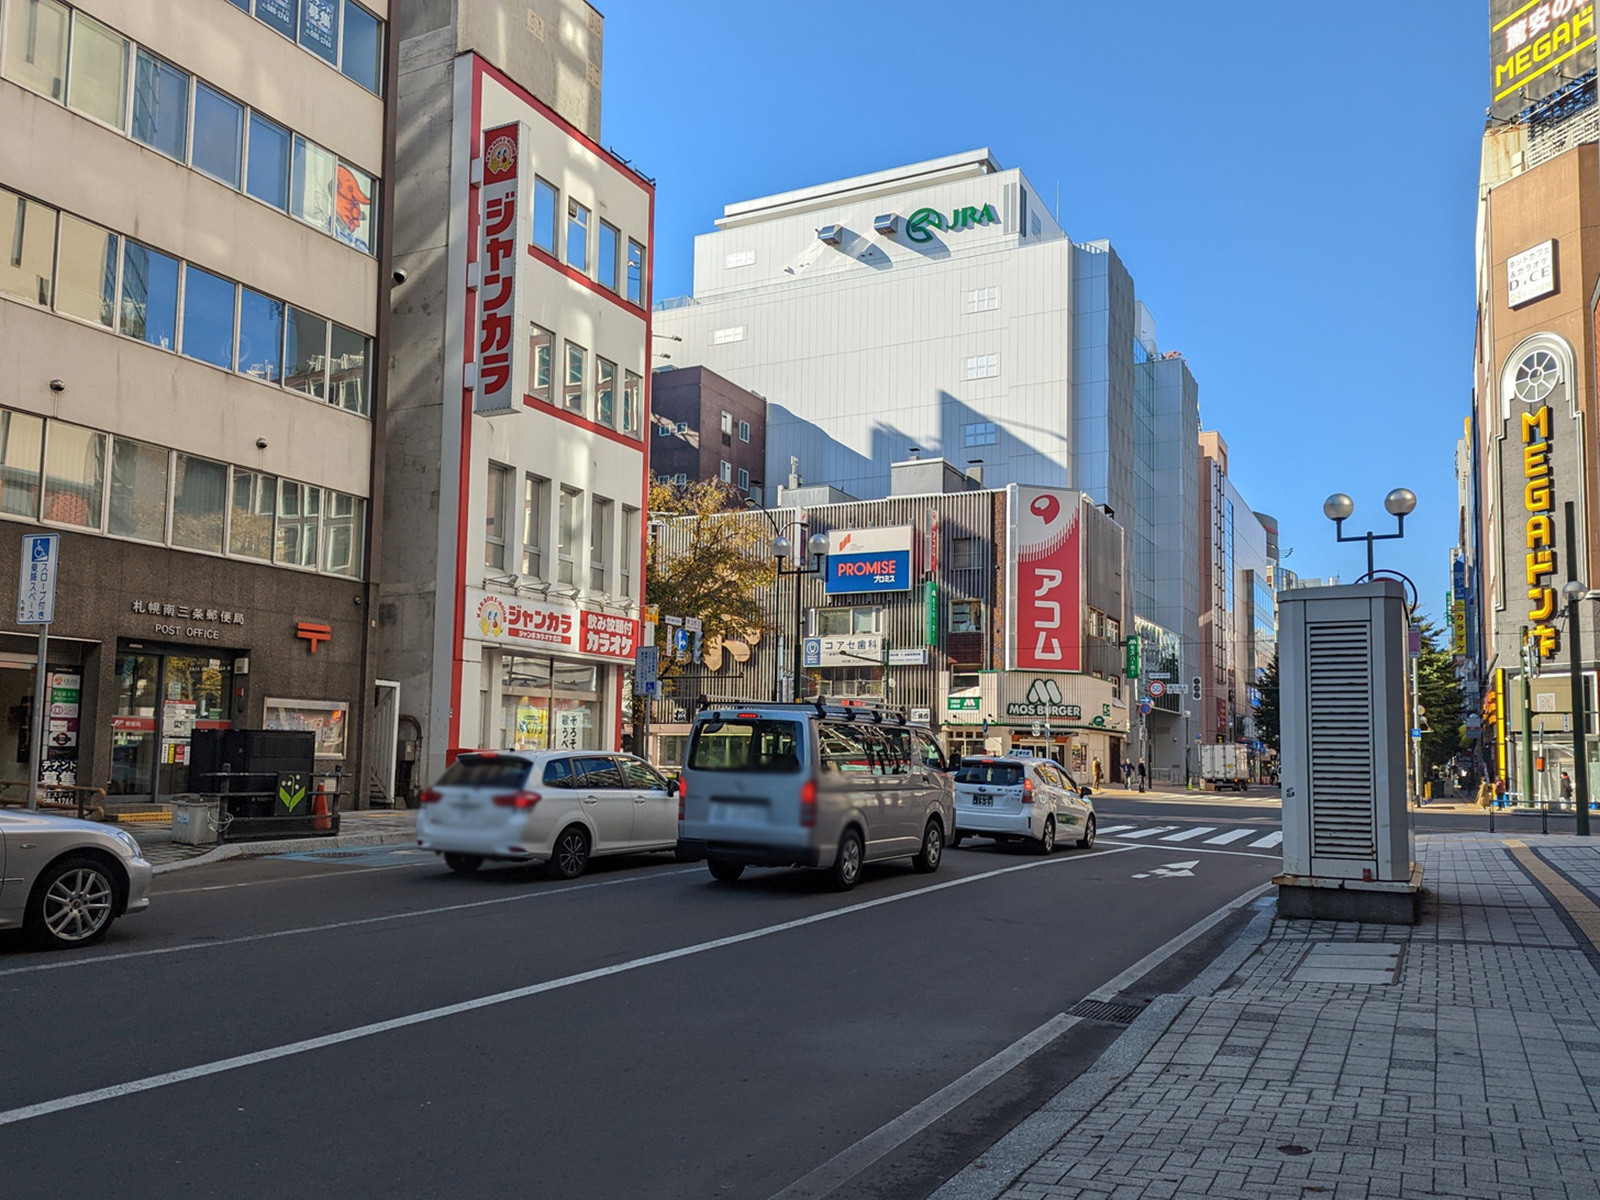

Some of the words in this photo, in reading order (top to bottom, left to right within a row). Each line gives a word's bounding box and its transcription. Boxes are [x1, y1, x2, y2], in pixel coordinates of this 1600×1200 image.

[1505, 0, 1590, 53] 驚安の
[946, 203, 994, 230] JRA
[1509, 247, 1550, 269] ネットカフェ
[481, 191, 515, 395] ジャンカラ
[837, 560, 897, 577] PROMISE
[873, 574, 896, 584] プロミス
[27, 563, 38, 620] 乗降スペース
[38, 563, 48, 620] スロープ付き
[133, 600, 246, 625] 札幌南三条郵便局
[508, 605, 572, 634] ジャンカラ
[587, 613, 633, 636] 飲み放題付
[1034, 567, 1063, 661] アコム
[155, 624, 181, 635] POST
[186, 627, 220, 640] OFFICE
[586, 632, 633, 656] カラオケ
[1456, 613, 1465, 652] カラオケ
[824, 639, 878, 650] コアセ歯科
[1152, 684, 1163, 692] 50
[1008, 704, 1035, 715] MOS
[1037, 705, 1081, 717] BURGER
[561, 714, 569, 748] 歌うべ
[570, 715, 578, 750] そろそ
[42, 760, 77, 770] テナント
[41, 770, 76, 786] 募集
